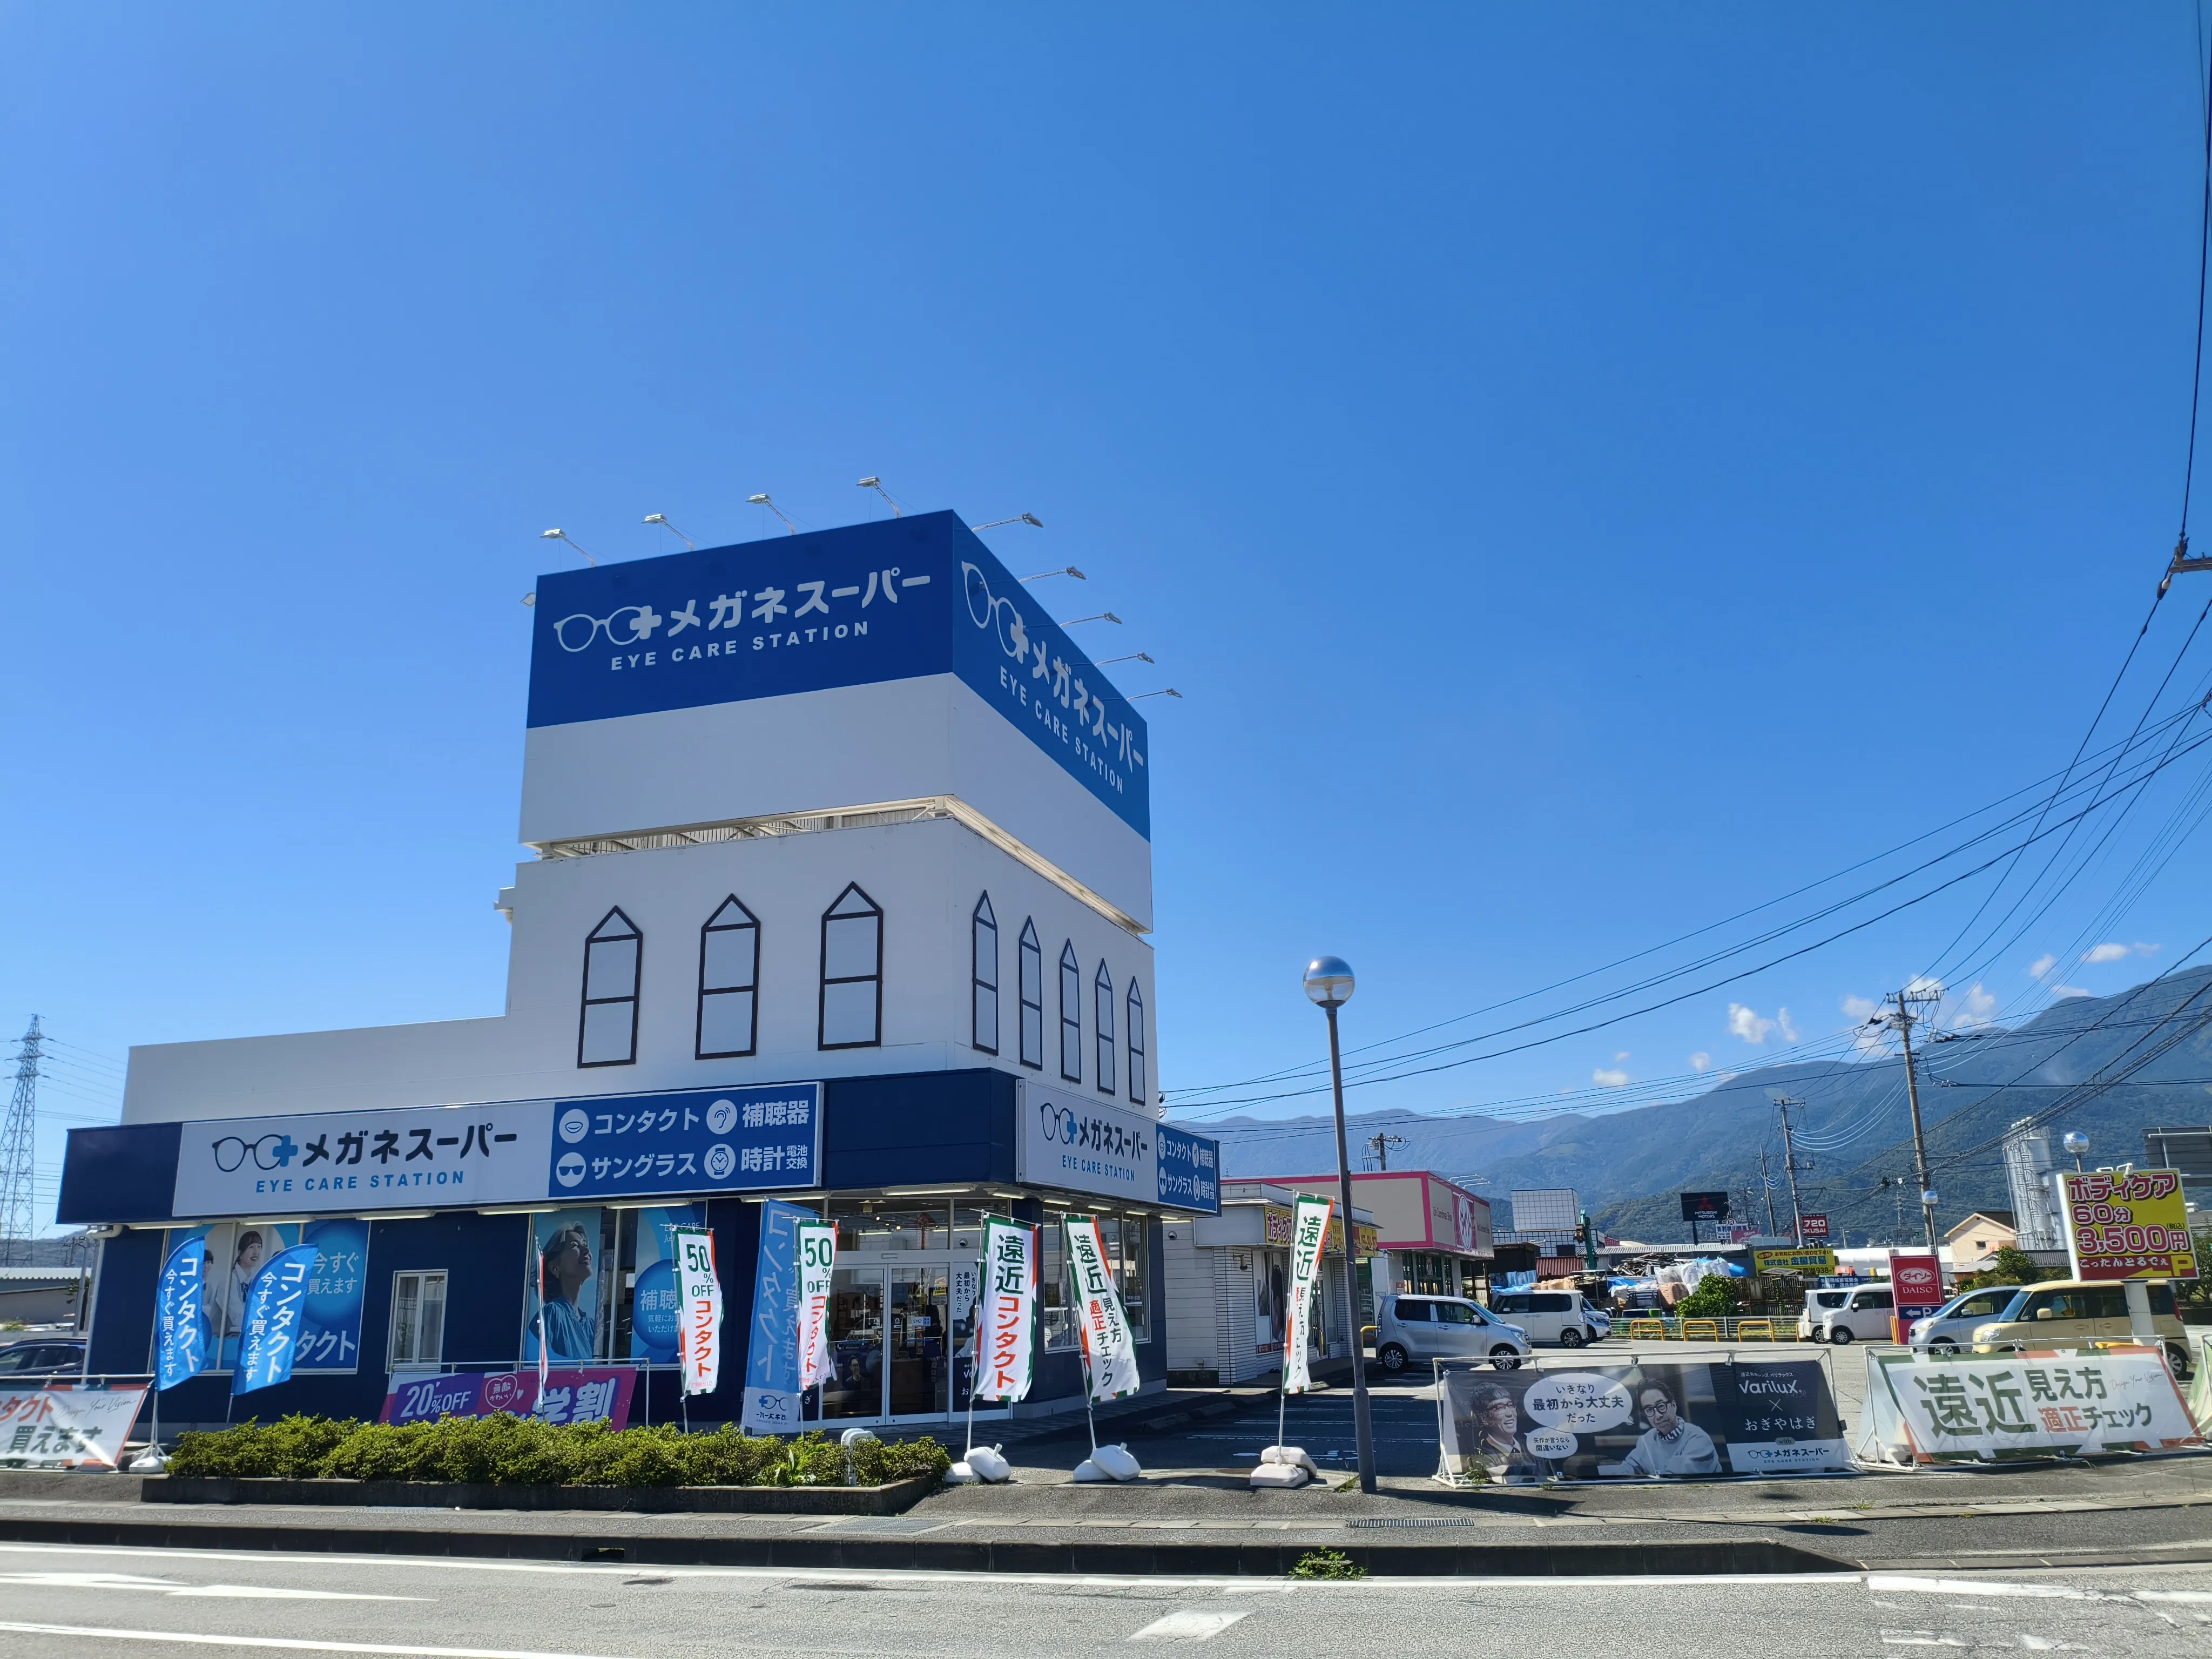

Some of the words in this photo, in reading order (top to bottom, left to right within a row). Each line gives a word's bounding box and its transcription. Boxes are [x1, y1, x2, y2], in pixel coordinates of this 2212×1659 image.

[667, 567, 930, 637] メガネスーパー
[611, 651, 656, 671] EYE
[672, 640, 737, 663] CARE
[752, 621, 868, 651] STATION
[1032, 640, 1143, 773] メガネスーパー
[1000, 665, 1027, 707] EYE
[1035, 699, 1069, 745] CARE
[1075, 736, 1123, 795] STATION
[594, 1108, 700, 1135] コンタクト
[742, 1100, 810, 1128] 補聴器
[302, 1122, 517, 1168] メガネスーパー
[786, 1144, 808, 1157] 電池
[1079, 1116, 1148, 1162] メガネスーパー
[1166, 1139, 1191, 1162] コンタクト
[591, 1152, 697, 1181] サングラス
[741, 1145, 785, 1172] 時計
[786, 1157, 808, 1170] 交換
[1062, 1155, 1077, 1170] EYE
[1081, 1159, 1101, 1175] CARE
[1104, 1163, 1135, 1182] STATION
[255, 1179, 293, 1193] EYE
[305, 1176, 358, 1191] CARE
[370, 1170, 464, 1188] STATION
[1167, 1173, 1192, 1195] サングラス
[2066, 1172, 2179, 1202] ボディケア
[2071, 1203, 2133, 1225] 60分
[804, 1237, 833, 1269] 50
[1296, 1216, 1322, 1281] 遠近
[2074, 1224, 2191, 1255] 3,500円
[686, 1244, 711, 1272] 50
[1074, 1233, 1108, 1294] 遠近
[1764, 1258, 1789, 1266] 株式会社
[2170, 1255, 2195, 1277] P
[703, 1273, 714, 1284] %
[807, 1280, 831, 1294] OFF
[1903, 1272, 1931, 1280] ダイソー
[691, 1285, 714, 1297] OFF
[161, 1268, 178, 1378] 今すぐ買えます
[177, 1257, 200, 1373] コンタクト
[266, 1262, 306, 1384] コンタクト
[1103, 1297, 1122, 1344] 見え方
[1922, 1307, 1932, 1319] P
[243, 1271, 278, 1384] 今すぐ買えます
[694, 1300, 713, 1378] コンタクト
[805, 1296, 826, 1373] コンタクト
[1556, 1383, 1595, 1395] いきなり
[2024, 1366, 2108, 1402] 見え方
[0, 1395, 53, 1423] タクト
[1533, 1395, 1625, 1412] 最初から大丈夫
[1913, 1370, 2038, 1439] 遠近
[1566, 1413, 1596, 1424] だった
[1745, 1415, 1816, 1431] おぎやはぎ
[2036, 1402, 2153, 1434] 適正チェック
[1536, 1444, 1569, 1452] 間違いない
[1774, 1447, 1830, 1458] メガネスーパー
